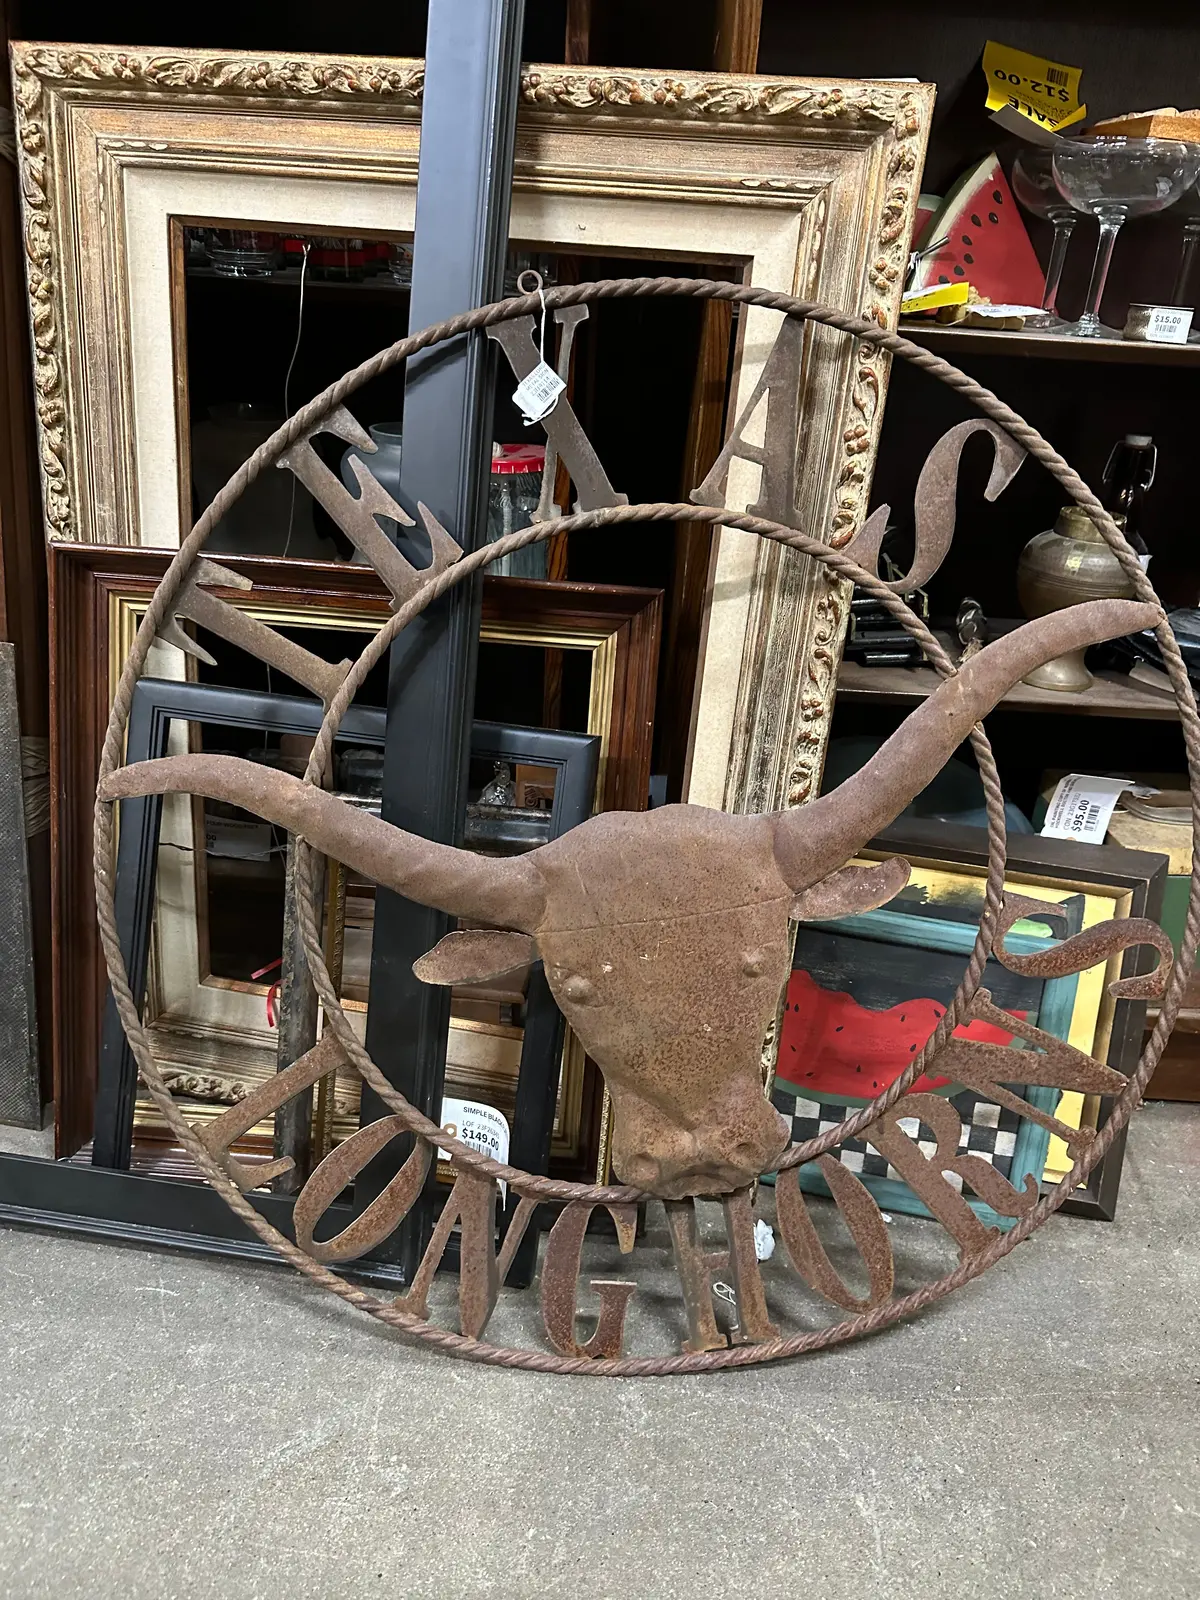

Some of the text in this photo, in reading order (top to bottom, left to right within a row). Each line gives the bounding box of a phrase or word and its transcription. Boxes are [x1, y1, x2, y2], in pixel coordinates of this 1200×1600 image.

[994, 69, 1070, 102] $12.00
[1007, 94, 1060, 128] SALE
[1154, 315, 1182, 325] $15.00
[155, 303, 1028, 712] TEXAS
[1070, 799, 1090, 832] $95.00
[191, 890, 1174, 1359] LONGHORNS
[463, 1106, 488, 1118] SIMPLE
[462, 1127, 500, 1151] $149.00
